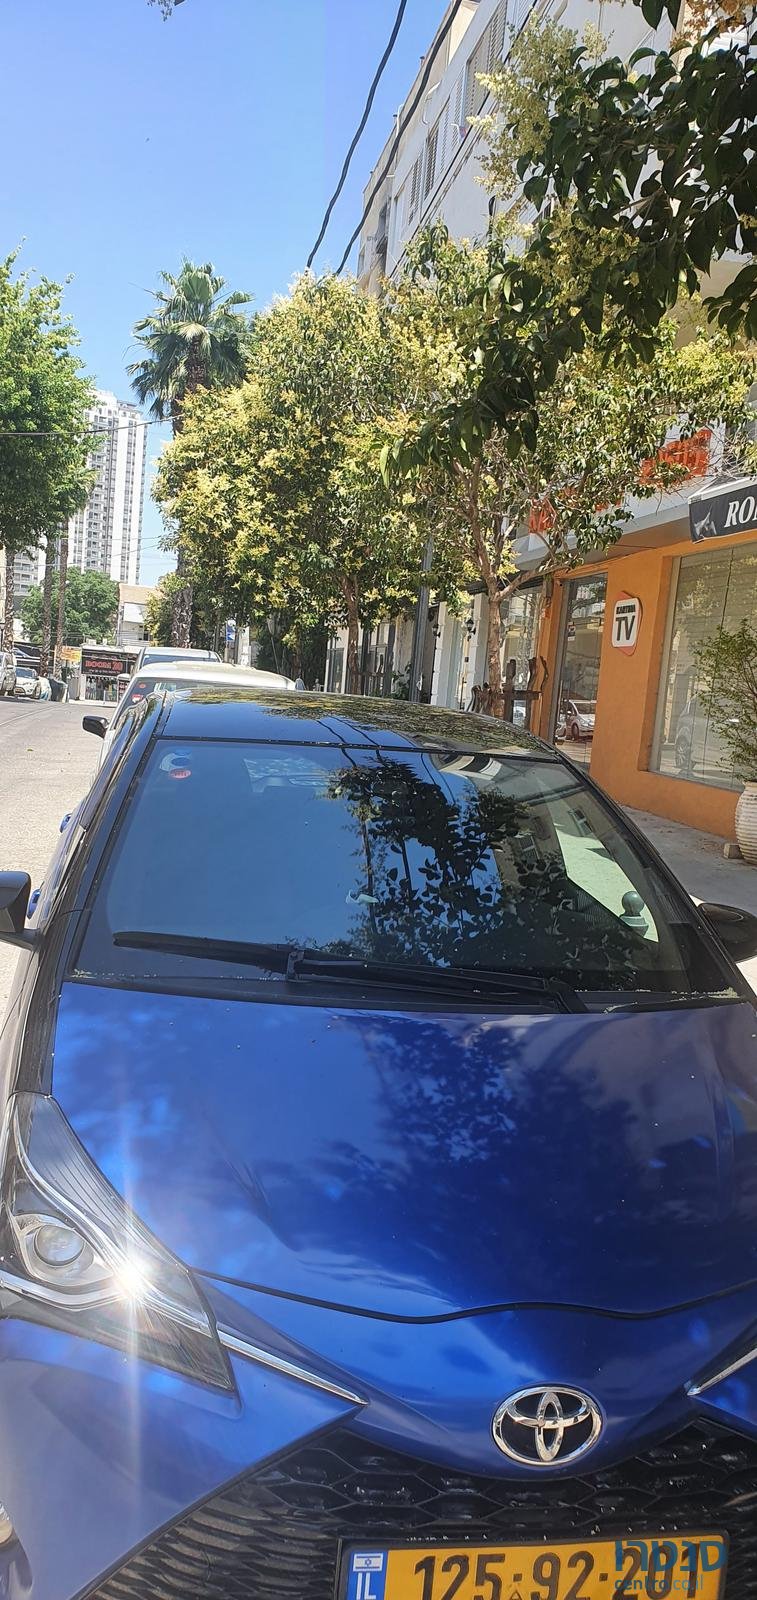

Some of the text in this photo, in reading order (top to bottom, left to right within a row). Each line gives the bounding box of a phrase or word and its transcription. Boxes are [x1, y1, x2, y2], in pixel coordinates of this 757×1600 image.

[724, 496, 757, 528] RO
[615, 615, 636, 641] TV
[356, 1572, 377, 1600] IL
